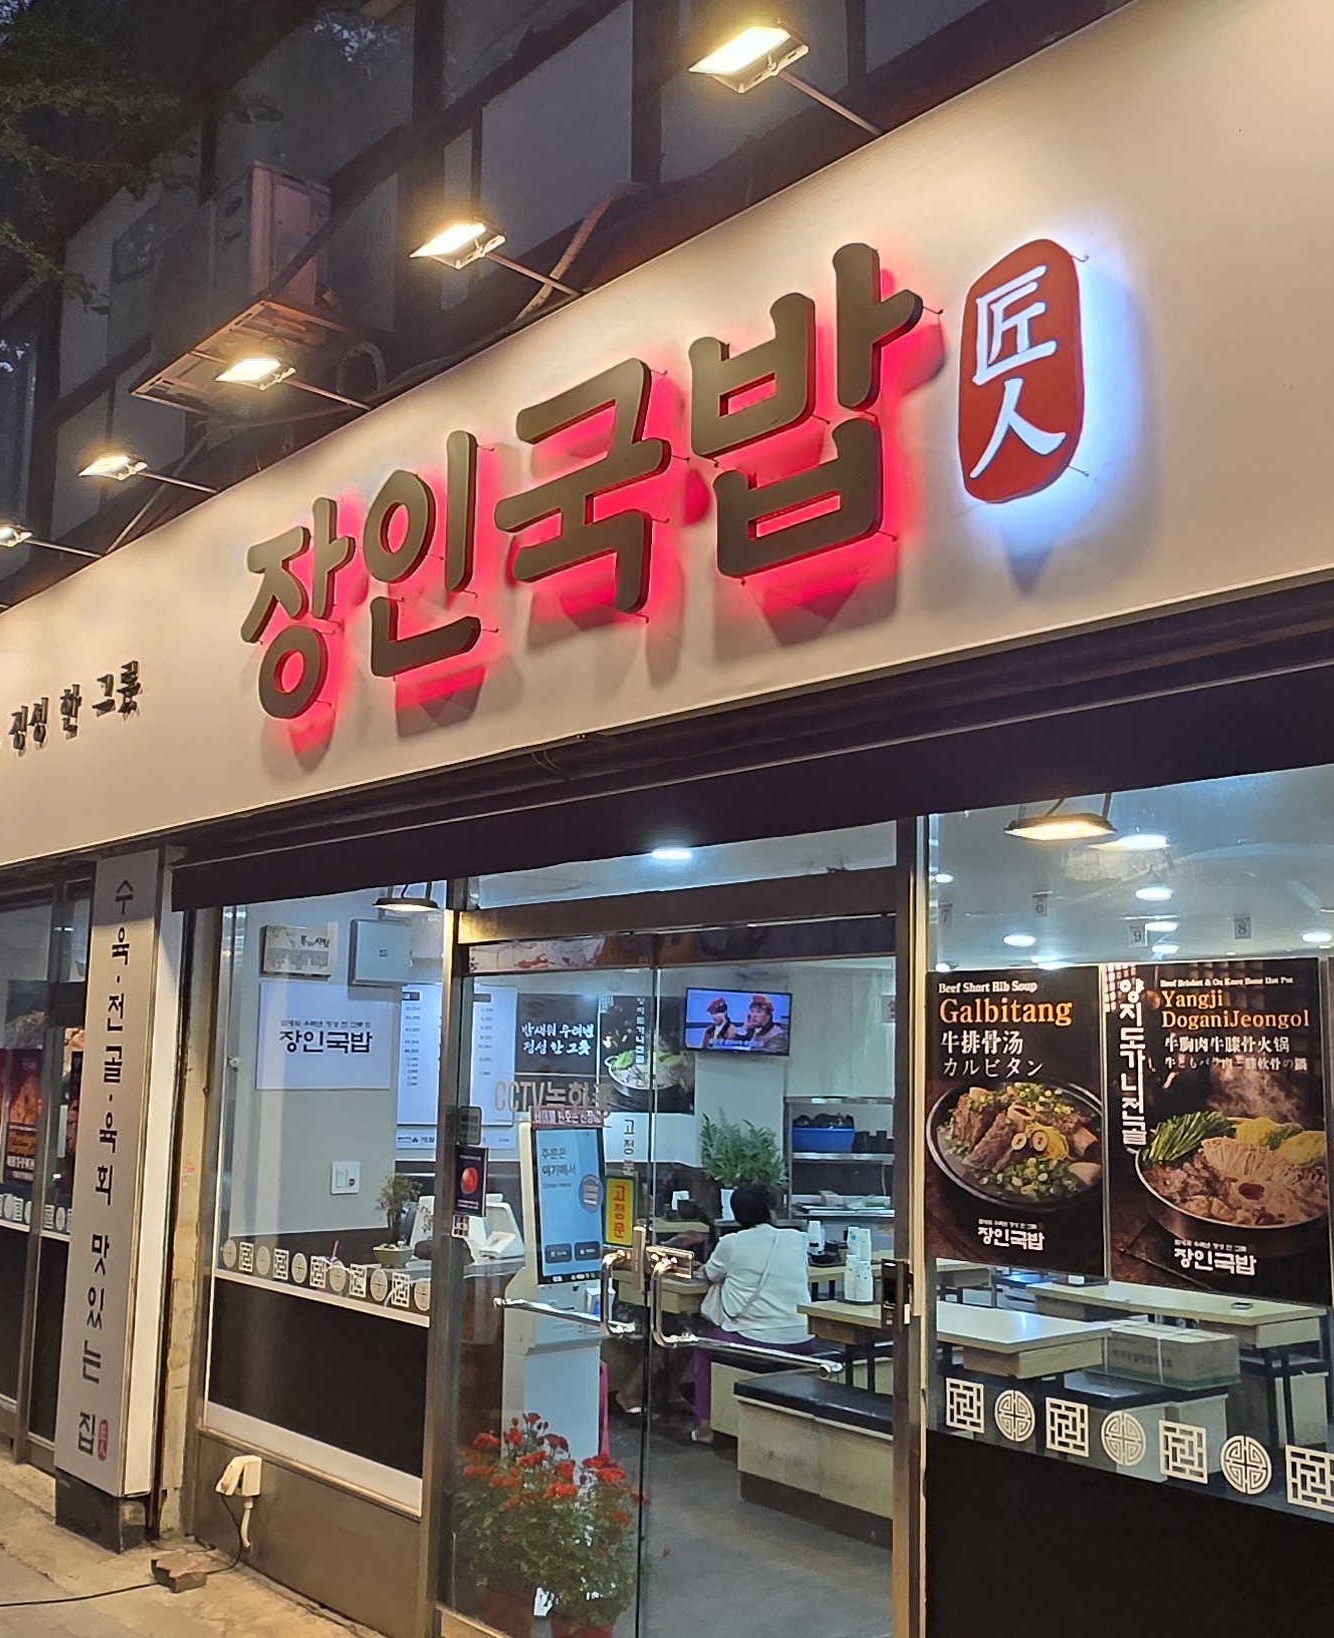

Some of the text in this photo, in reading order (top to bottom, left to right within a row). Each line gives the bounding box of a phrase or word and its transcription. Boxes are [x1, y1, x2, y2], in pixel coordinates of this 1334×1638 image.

[971, 265, 1066, 478] 匠人
[241, 243, 923, 720] 장인국밥
[8, 697, 50, 753] 정성
[60, 684, 83, 738] 한
[1237, 920, 1247, 935] 8
[938, 980, 1038, 993] Beef Short Rib Soup
[1161, 989, 1223, 1009] Yangji
[940, 997, 1072, 1026] Galbitang
[1161, 1009, 1310, 1030] DoganiJeongol
[279, 1030, 373, 1054] 장인국밥
[523, 1038, 547, 1055] 정성
[550, 1039, 564, 1055] 한
[941, 1030, 1023, 1054] 牛排骨汤
[943, 1057, 1043, 1078] カルビタン
[1120, 978, 1147, 1146] 양지도가니전골
[541, 1148, 566, 1159] 주문은
[613, 1185, 625, 1239] 고정문
[978, 1227, 1045, 1250] 장인국밥
[1174, 1248, 1257, 1276] 장인국밥
[82, 1234, 110, 1385] 맛있는
[78, 1411, 96, 1456] 집
